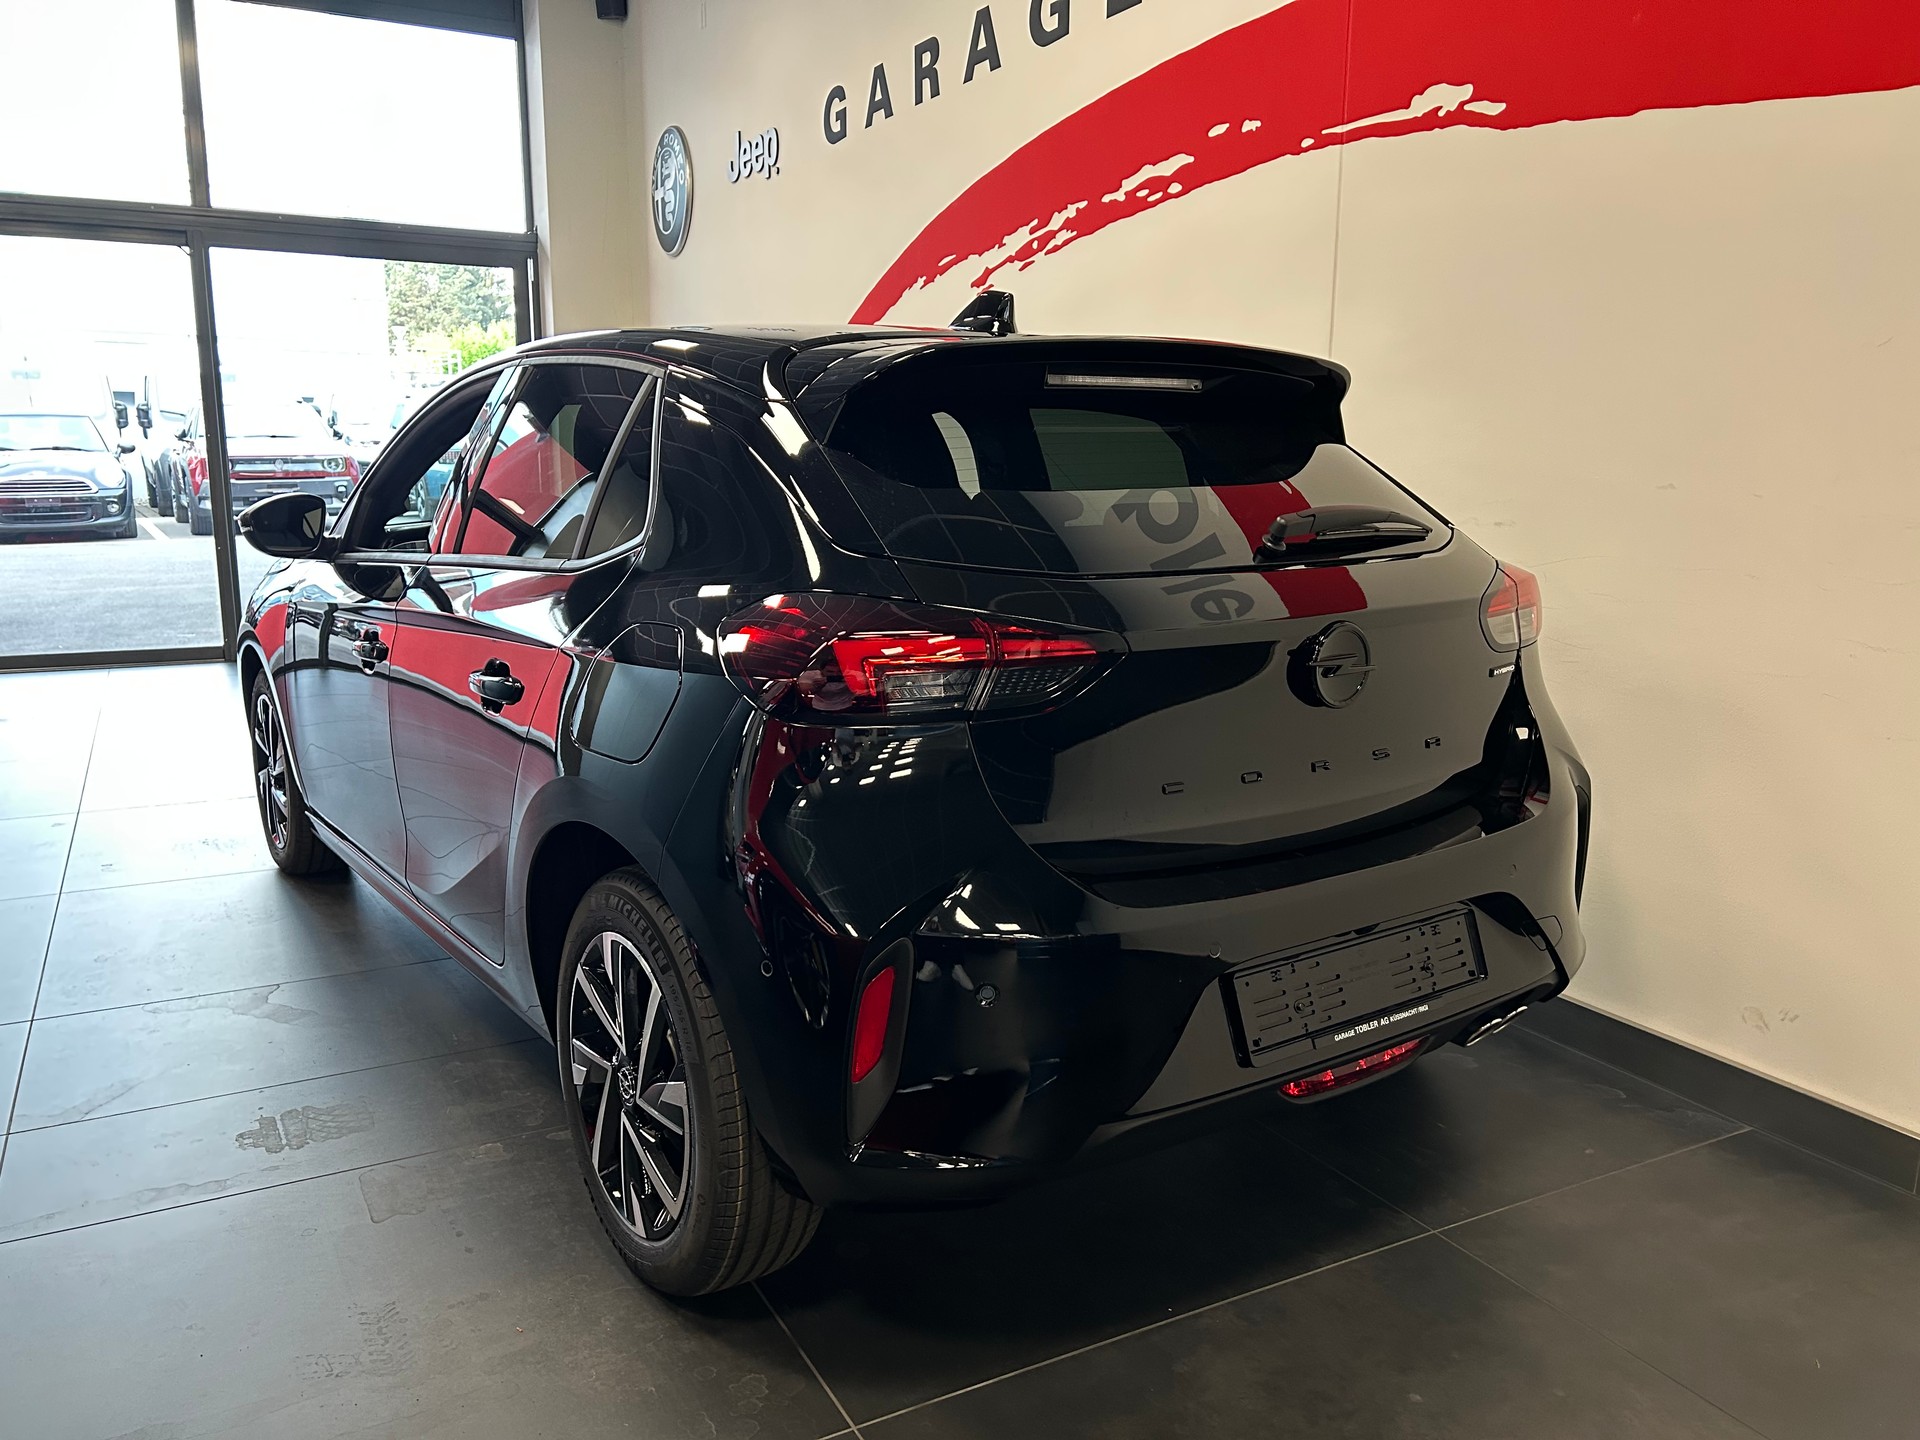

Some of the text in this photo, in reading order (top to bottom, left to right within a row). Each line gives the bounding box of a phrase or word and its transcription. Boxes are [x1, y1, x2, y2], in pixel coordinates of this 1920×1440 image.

[823, 0, 1143, 145] GARAG
[663, 133, 685, 185] ROMEO
[727, 126, 780, 184] Jeep
[1161, 735, 1442, 796] CORSA
[607, 894, 669, 973] MICHELIN
[1334, 1029, 1356, 1041] GARAGE
[1354, 1019, 1379, 1034] TOBLER
[1380, 1016, 1390, 1026] AG
